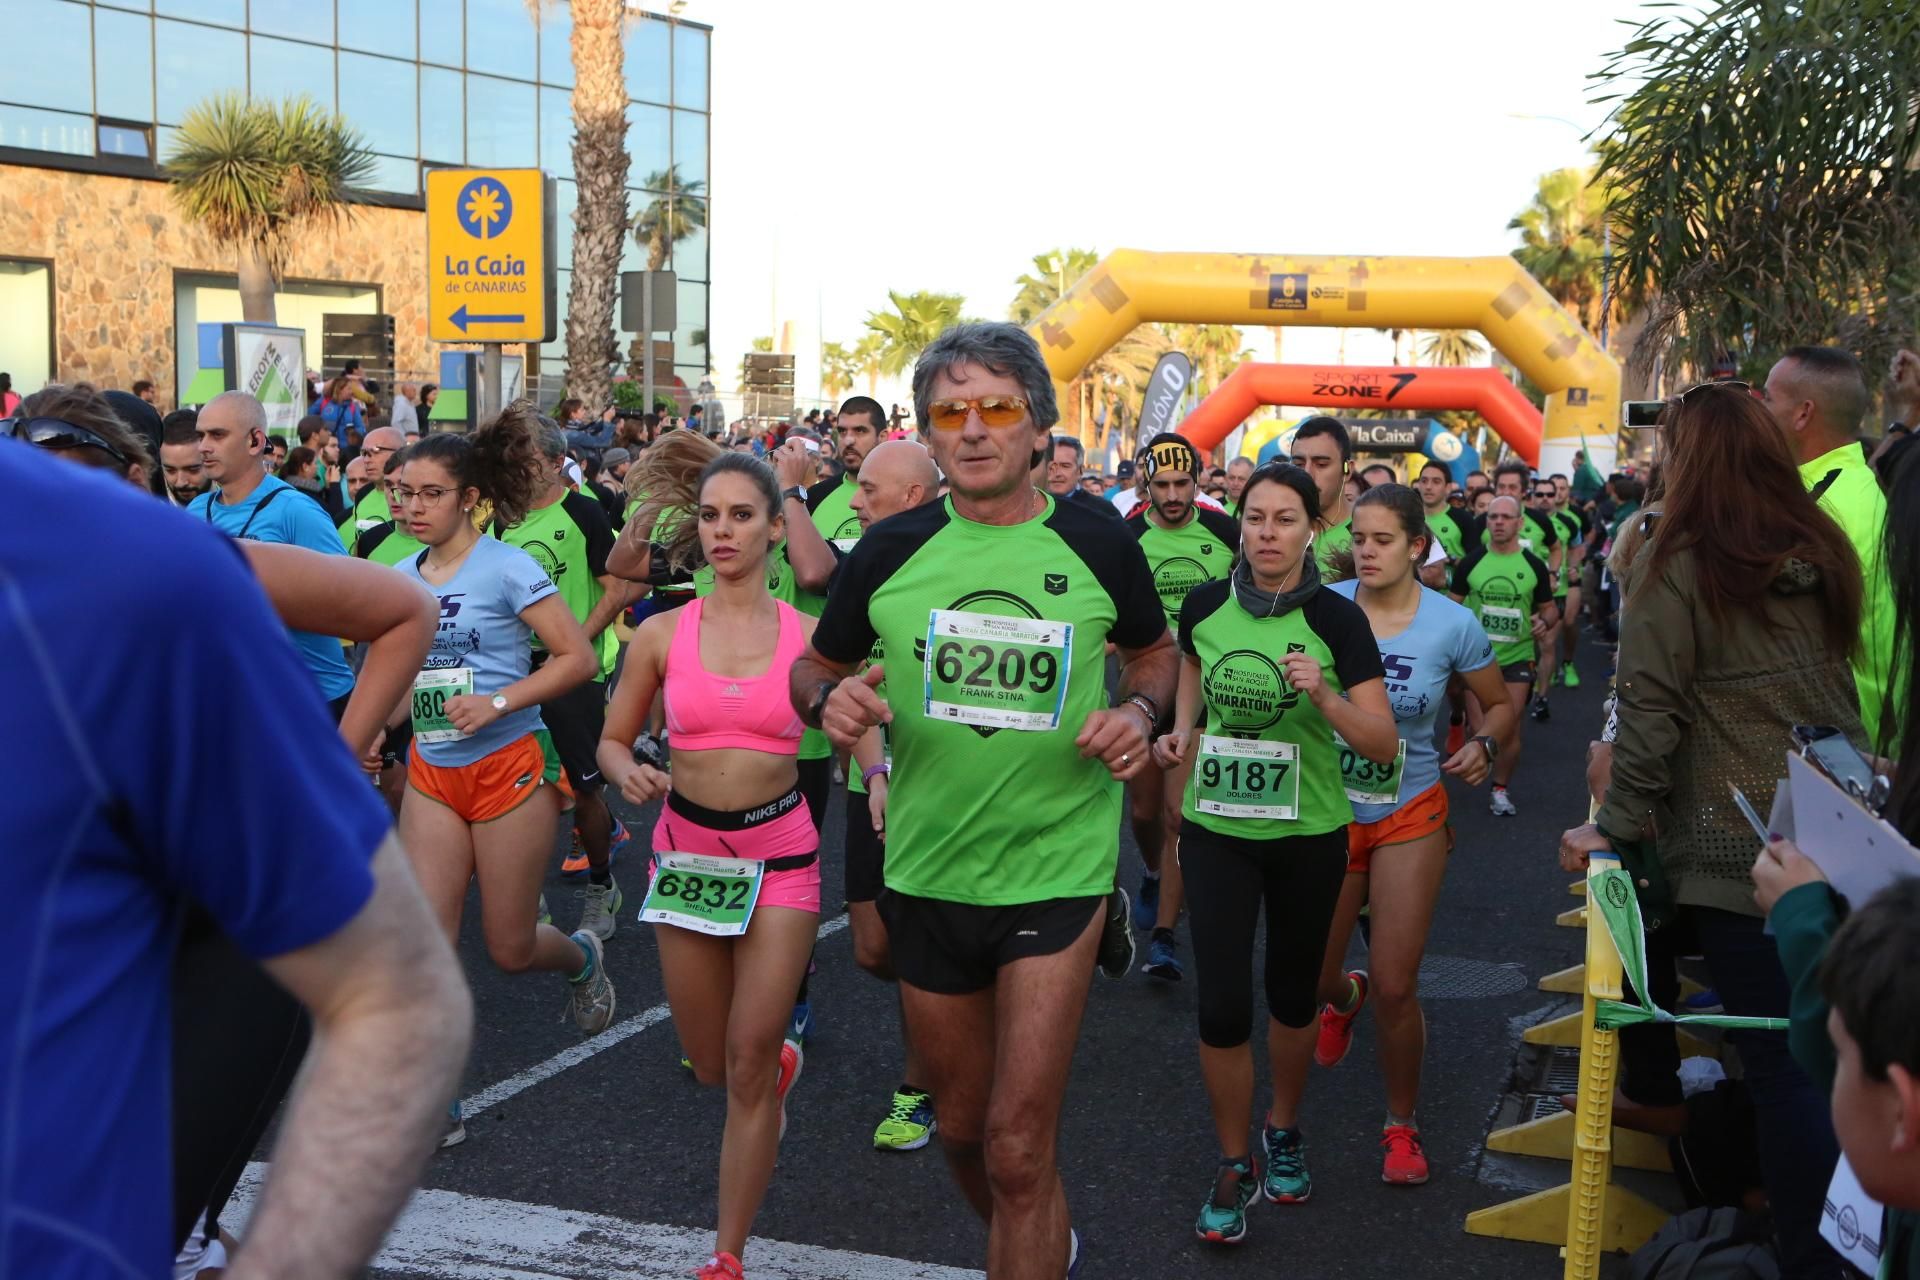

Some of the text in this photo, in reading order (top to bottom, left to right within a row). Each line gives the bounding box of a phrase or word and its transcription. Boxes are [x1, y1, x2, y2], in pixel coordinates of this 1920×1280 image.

[445, 254, 525, 276] La Caja
[445, 281, 527, 293] de CANARIAS
[245, 351, 270, 393] EROY
[1313, 371, 1382, 384] SPORT
[1312, 384, 1382, 398] ZONE
[1141, 388, 1175, 447] CAJÓN
[1175, 578, 1204, 587] CANARIA
[1482, 614, 1519, 632] 6335
[960, 626, 979, 635] GRAN
[980, 628, 1009, 638] CANARIA
[936, 641, 1057, 693] 6209
[1233, 670, 1270, 680] HOSPITALES
[1213, 681, 1276, 699] GRAN CANARIA
[1246, 679, 1269, 687] ROQUE
[960, 687, 995, 699] FRANK
[413, 688, 462, 720] 880
[1214, 692, 1273, 713] MARATÓN
[1232, 709, 1253, 718] 2016
[1202, 758, 1290, 792] 9187
[1226, 791, 1263, 799] DOLORES
[744, 790, 798, 823] NIKE PRO
[657, 873, 750, 910] 6832
[684, 902, 712, 914] SHEILA
